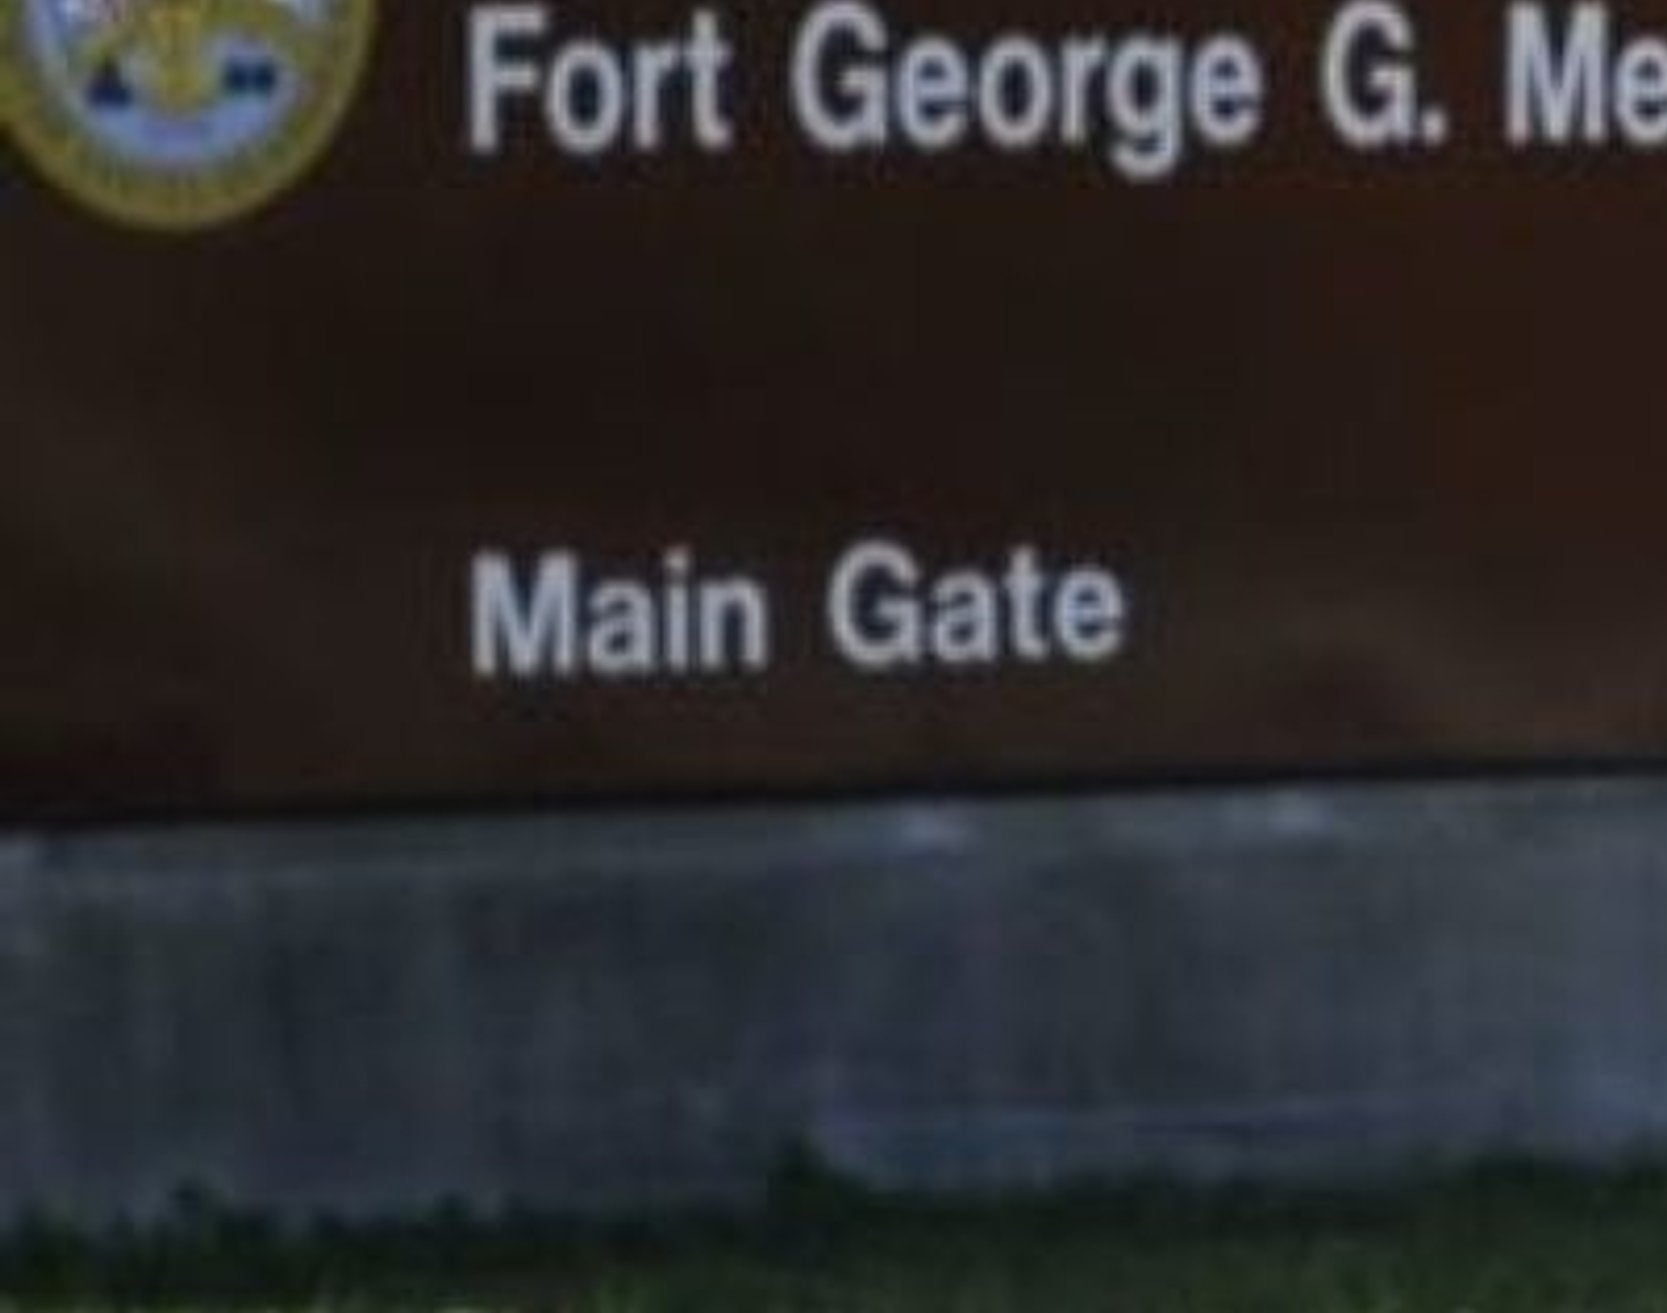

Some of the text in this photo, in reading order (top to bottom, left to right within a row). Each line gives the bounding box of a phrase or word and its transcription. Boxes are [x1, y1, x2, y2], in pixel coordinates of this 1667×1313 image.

[471, 5, 729, 151] Fort
[792, 0, 1261, 176] George
[474, 542, 1123, 673] Main Gate
